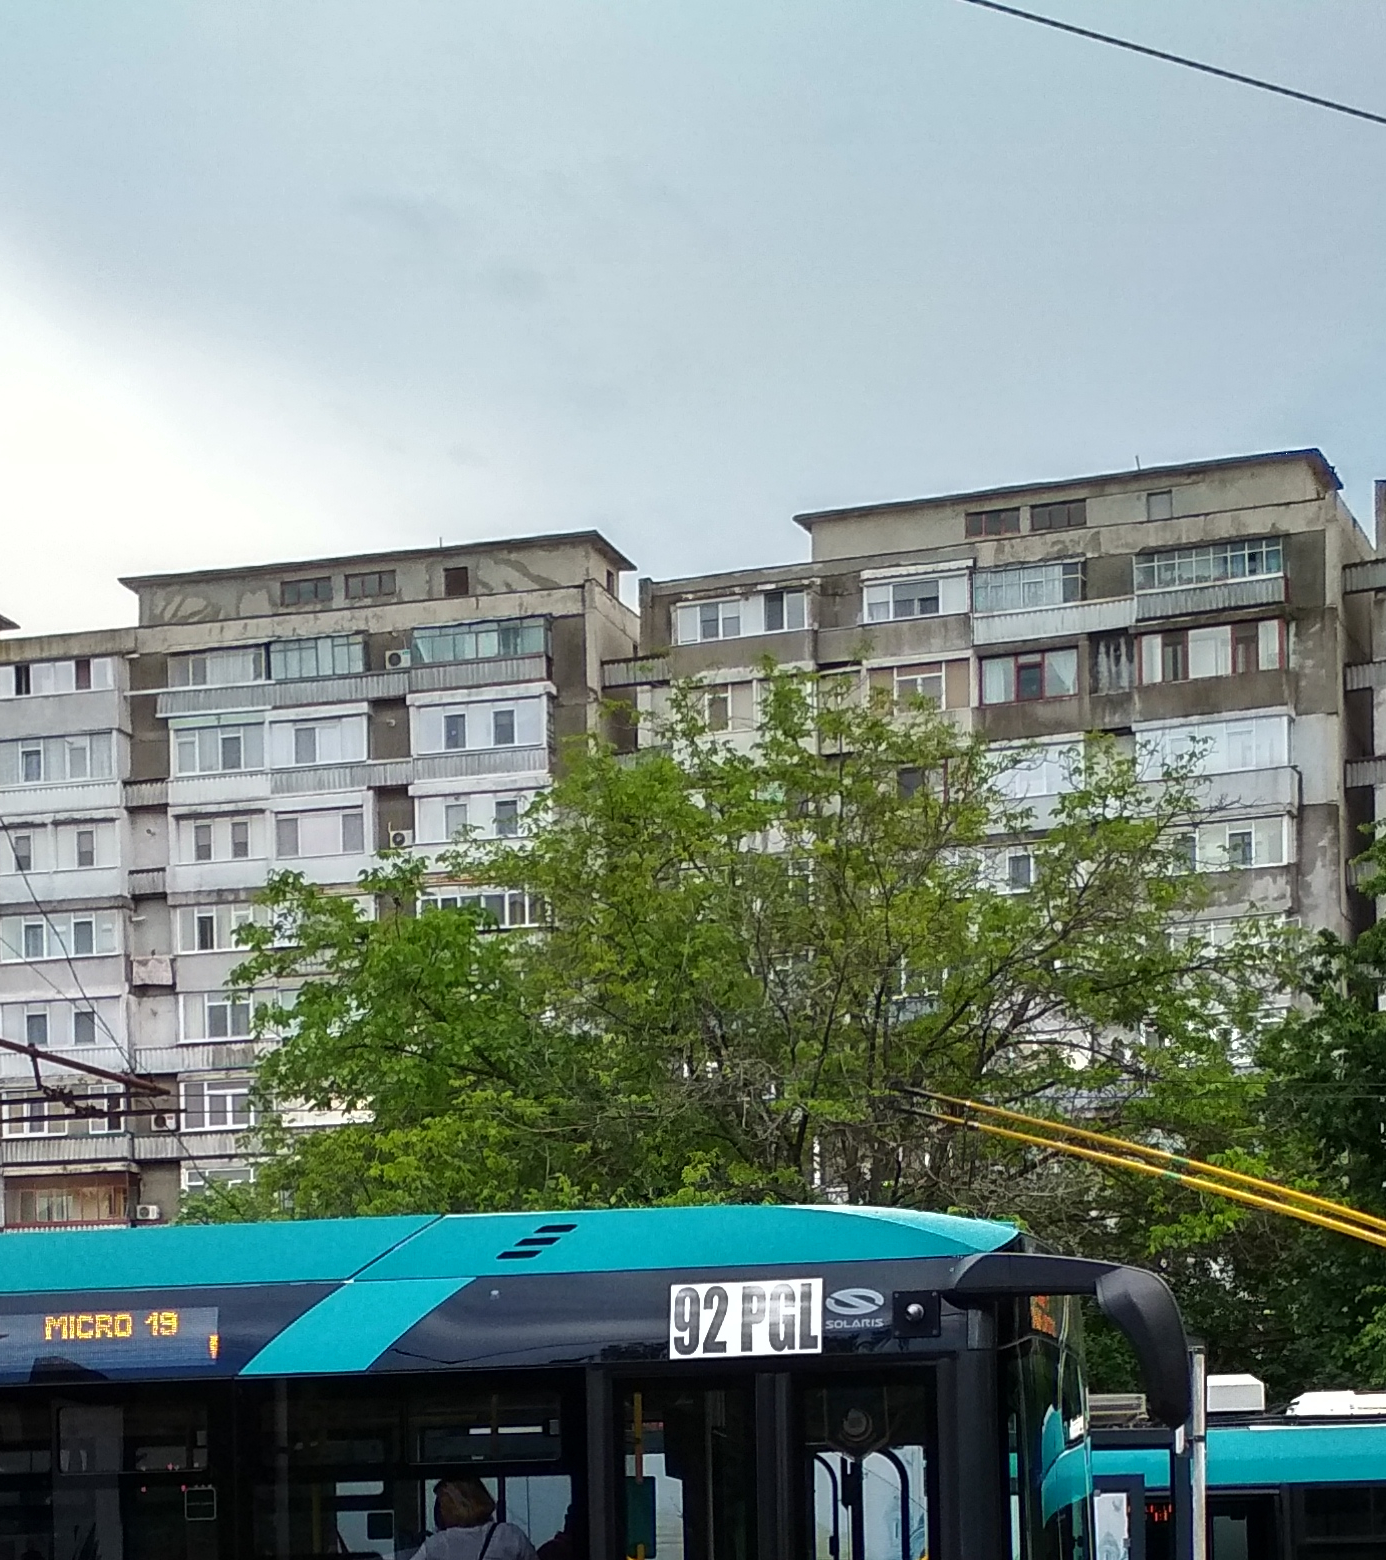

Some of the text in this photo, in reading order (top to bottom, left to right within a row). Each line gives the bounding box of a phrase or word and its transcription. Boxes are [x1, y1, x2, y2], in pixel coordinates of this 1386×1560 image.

[44, 1311, 179, 1340] MICRO 19
[673, 1283, 818, 1355] 92 PGL
[825, 1317, 885, 1330] SOLARIS
